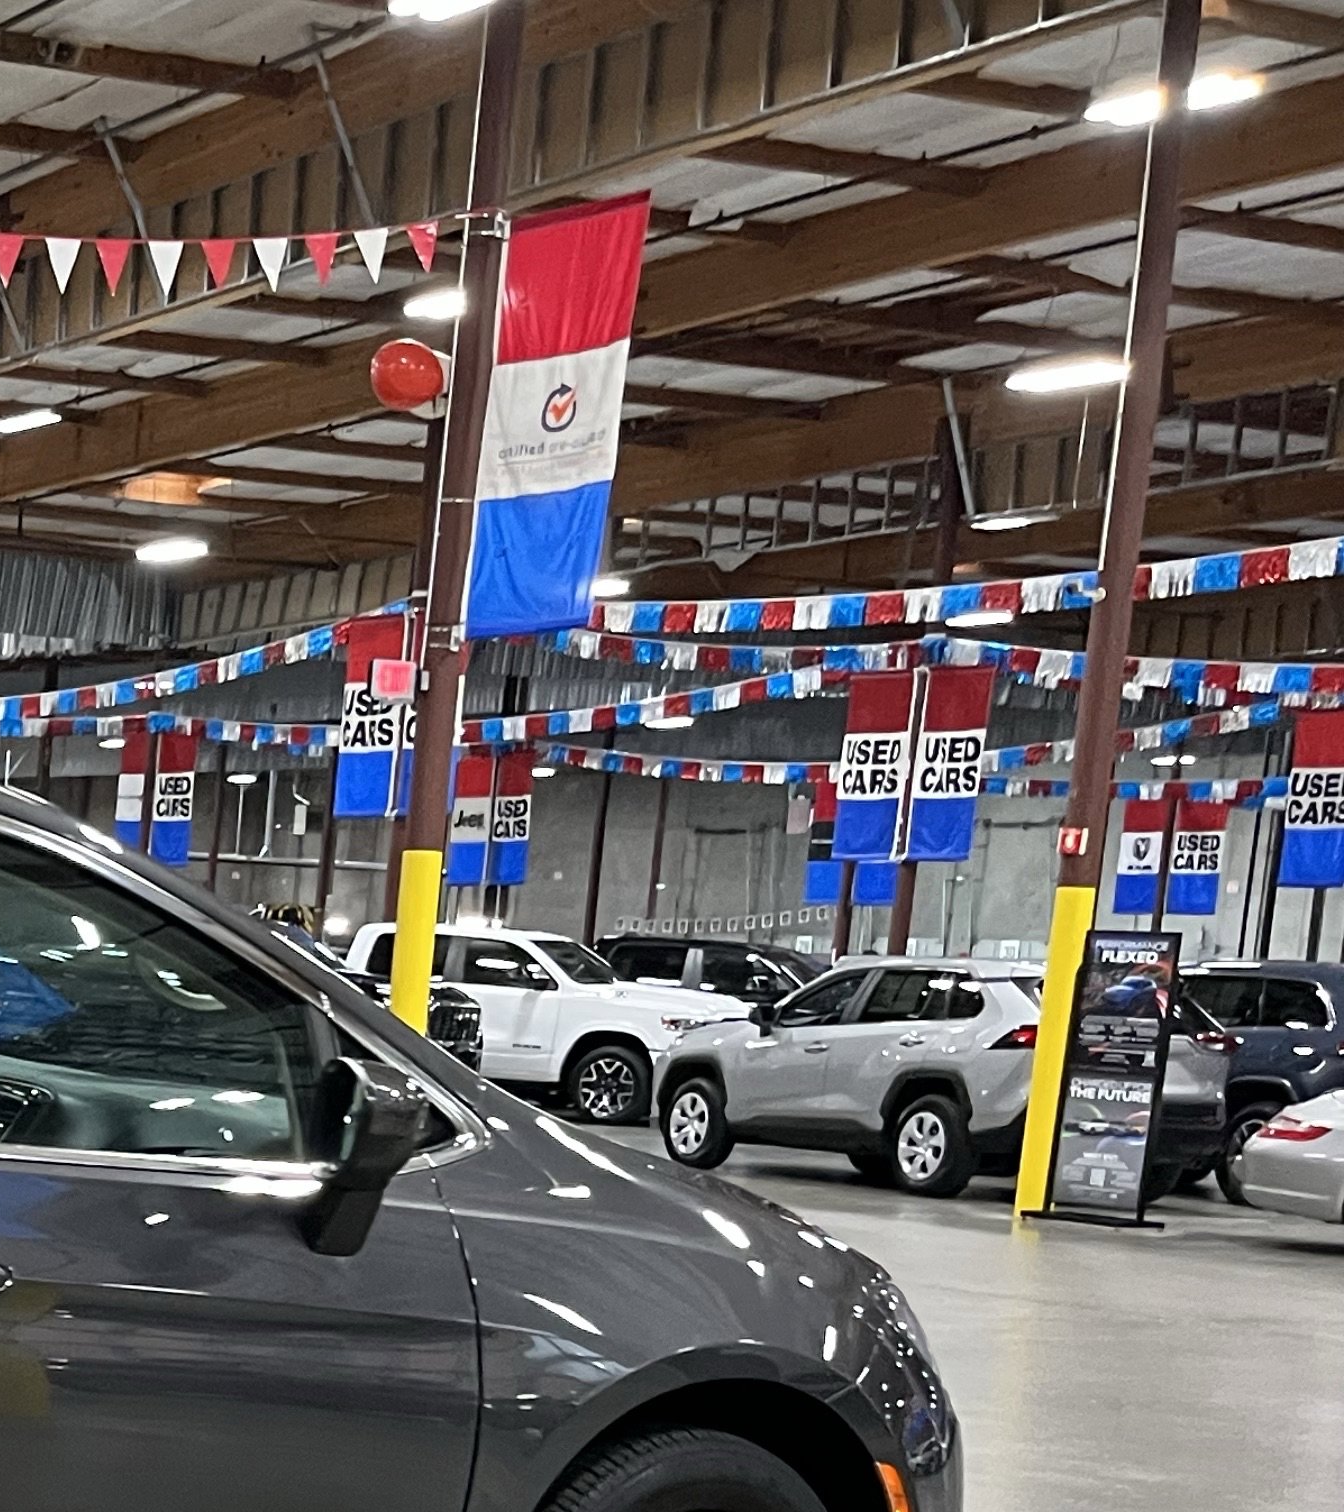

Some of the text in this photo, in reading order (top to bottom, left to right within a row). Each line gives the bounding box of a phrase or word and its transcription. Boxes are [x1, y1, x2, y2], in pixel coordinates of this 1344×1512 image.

[343, 718, 394, 746] CARS
[846, 739, 901, 765] USED
[926, 736, 981, 764] USED
[159, 776, 191, 795] USED
[843, 768, 898, 795] CARS
[920, 765, 978, 792] CARS
[1291, 773, 1344, 798] USE
[498, 799, 528, 818] USED
[1177, 834, 1221, 851] USED
[1174, 853, 1218, 870] CARS
[1070, 1086, 1151, 1104] THE FUTURE
